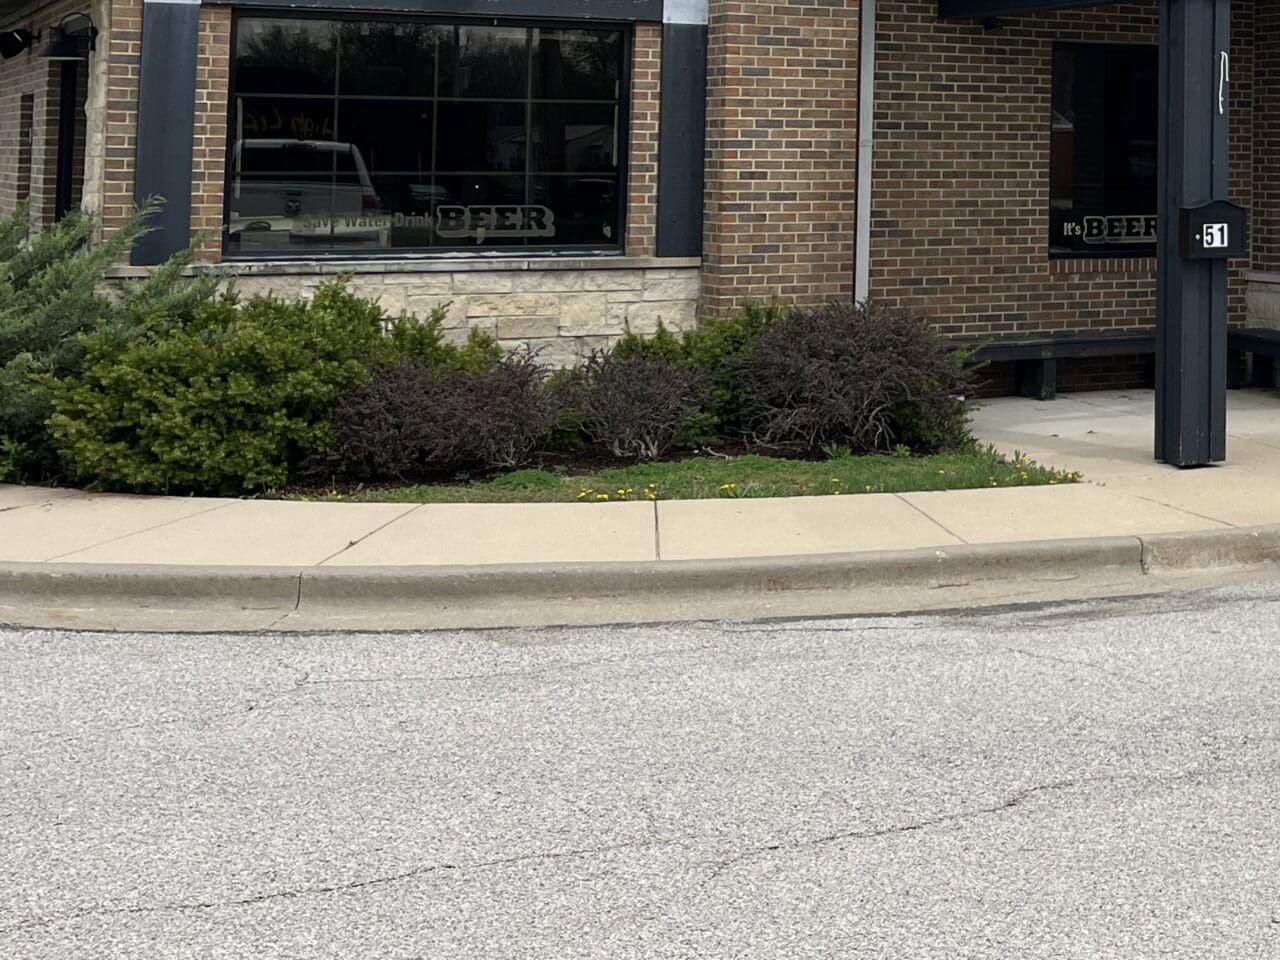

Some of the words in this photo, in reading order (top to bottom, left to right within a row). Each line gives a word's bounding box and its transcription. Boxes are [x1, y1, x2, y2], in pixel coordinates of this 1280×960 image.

[302, 214, 338, 231] Save
[344, 214, 388, 230] Water
[395, 211, 432, 228] Drink
[437, 206, 555, 237] BEER
[1062, 222, 1081, 236] It's
[1205, 225, 1226, 245] 51
